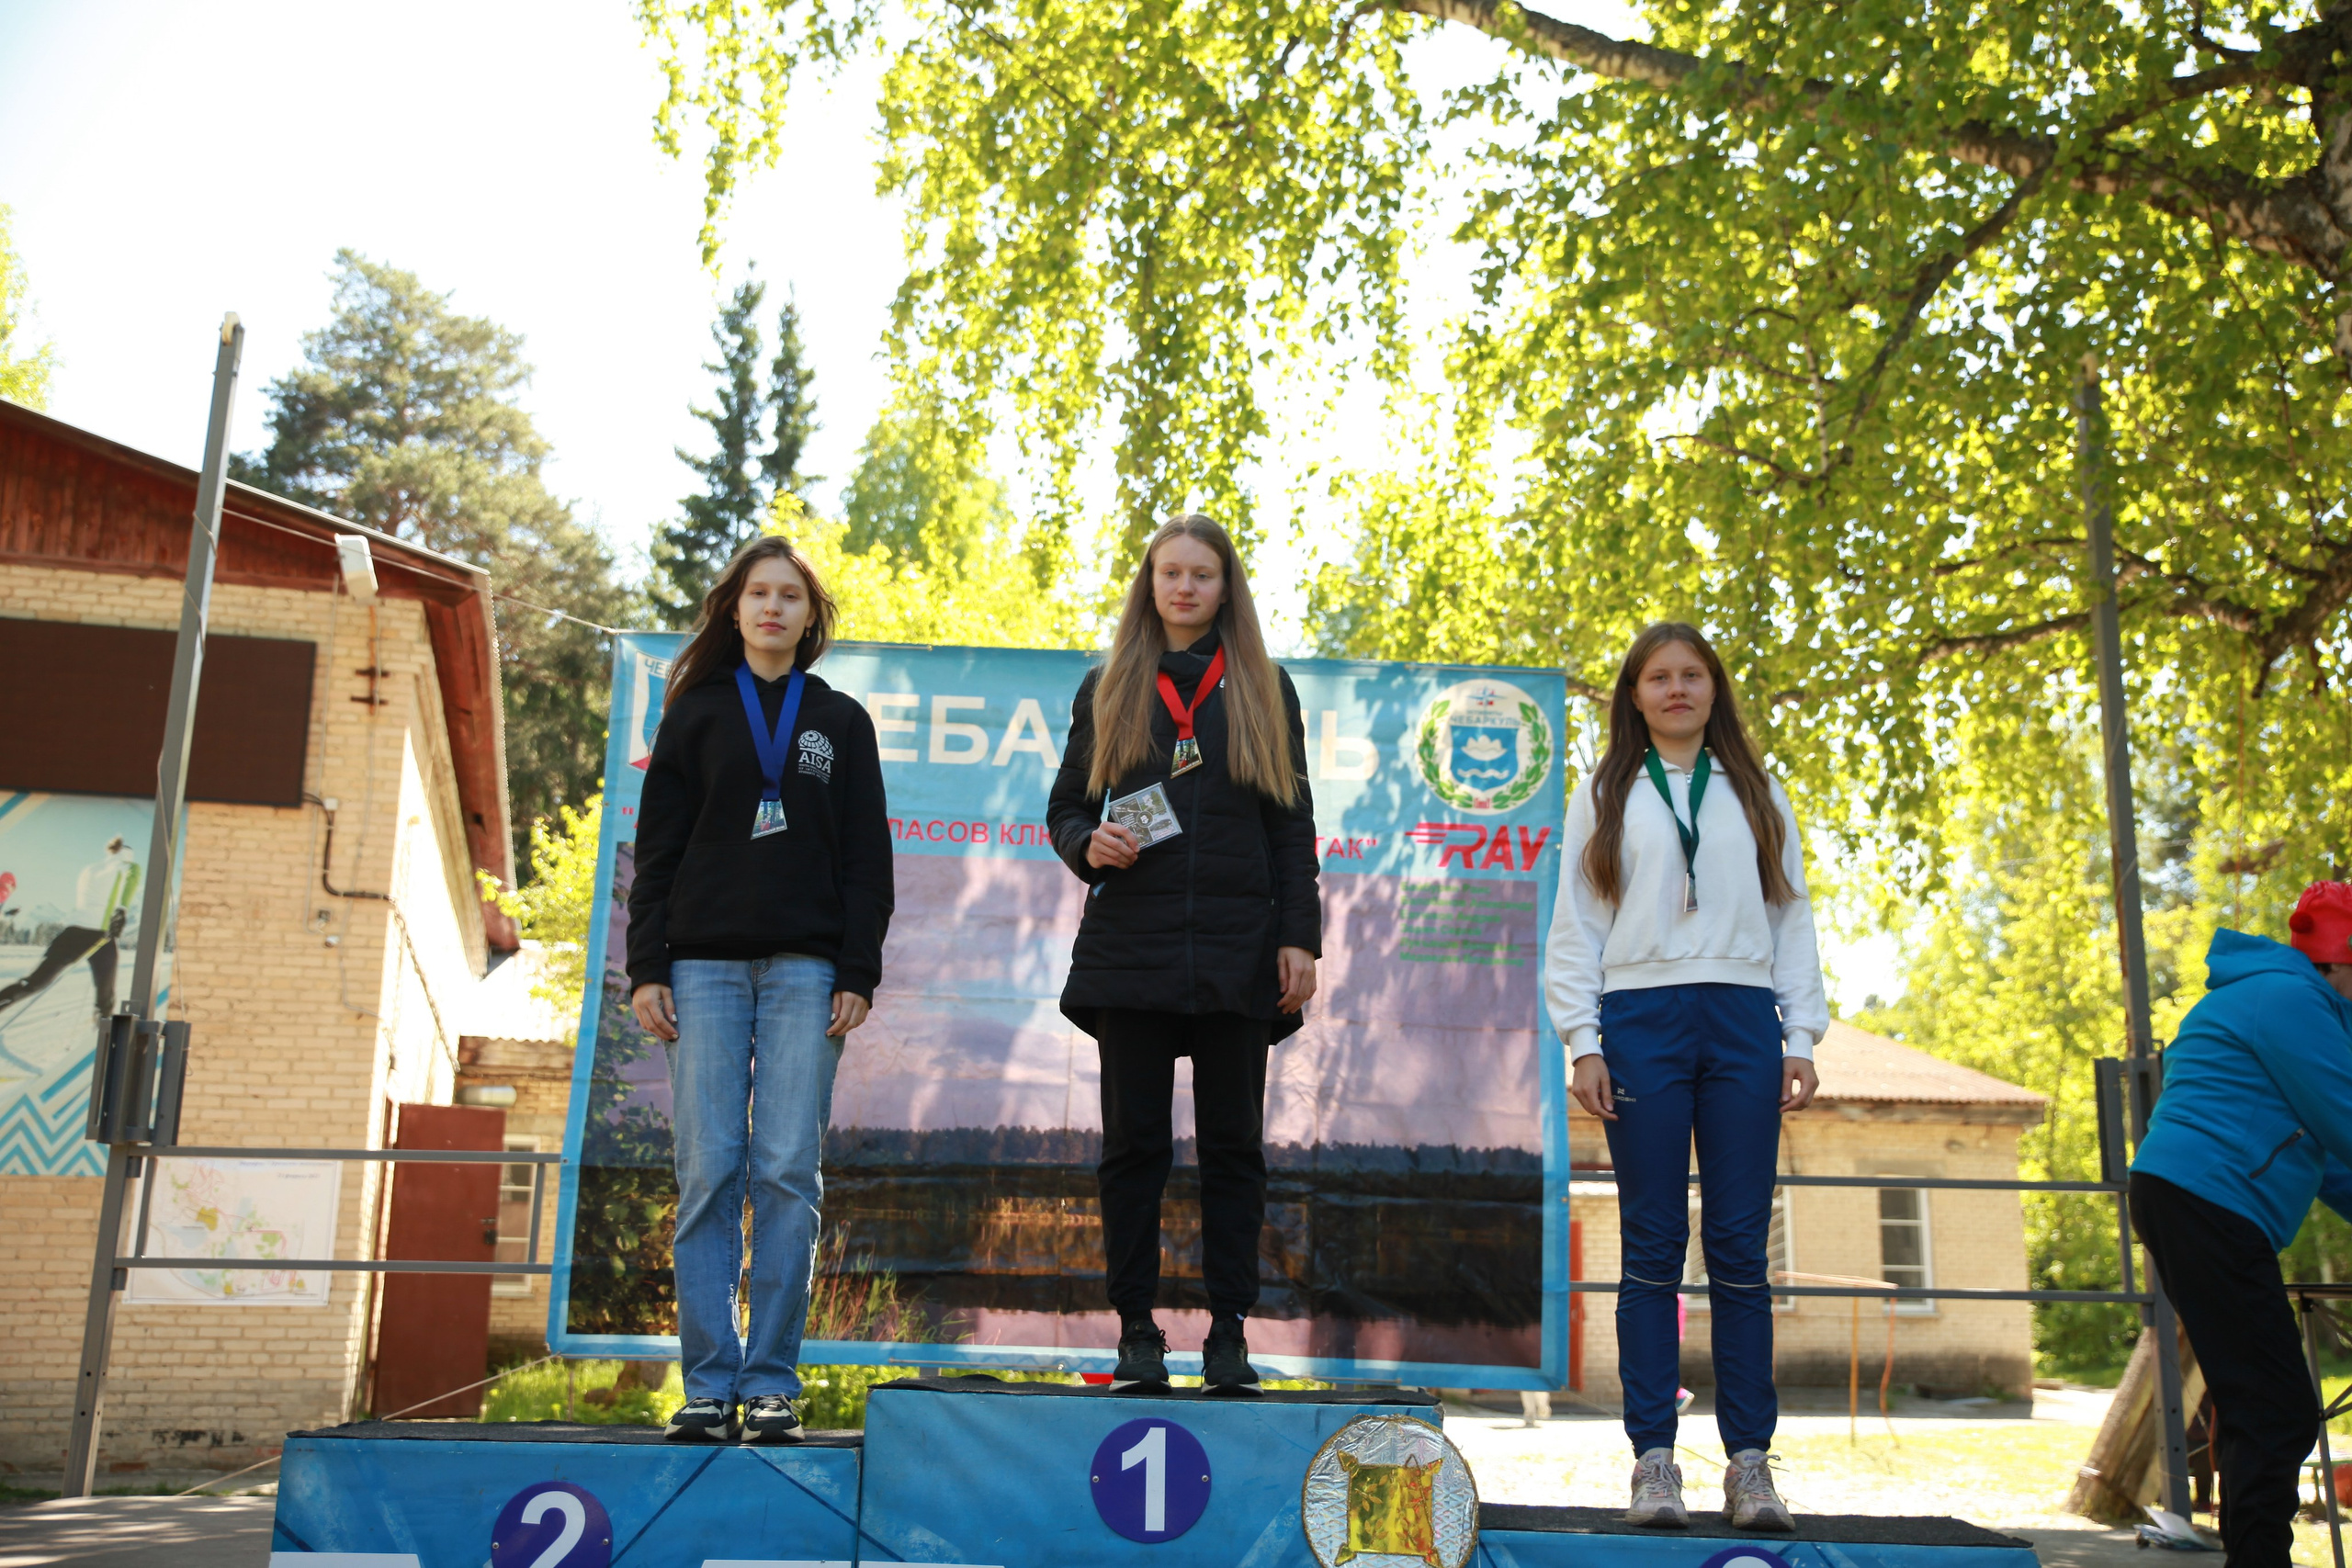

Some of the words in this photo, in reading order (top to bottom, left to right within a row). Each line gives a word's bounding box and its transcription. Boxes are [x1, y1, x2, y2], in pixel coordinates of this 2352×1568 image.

[644, 658, 671, 678] ЧЕ
[798, 751, 831, 774] AISA
[1406, 823, 1552, 872] RAY
[1121, 1427, 1166, 1531] 1
[521, 1491, 586, 1568] 2
